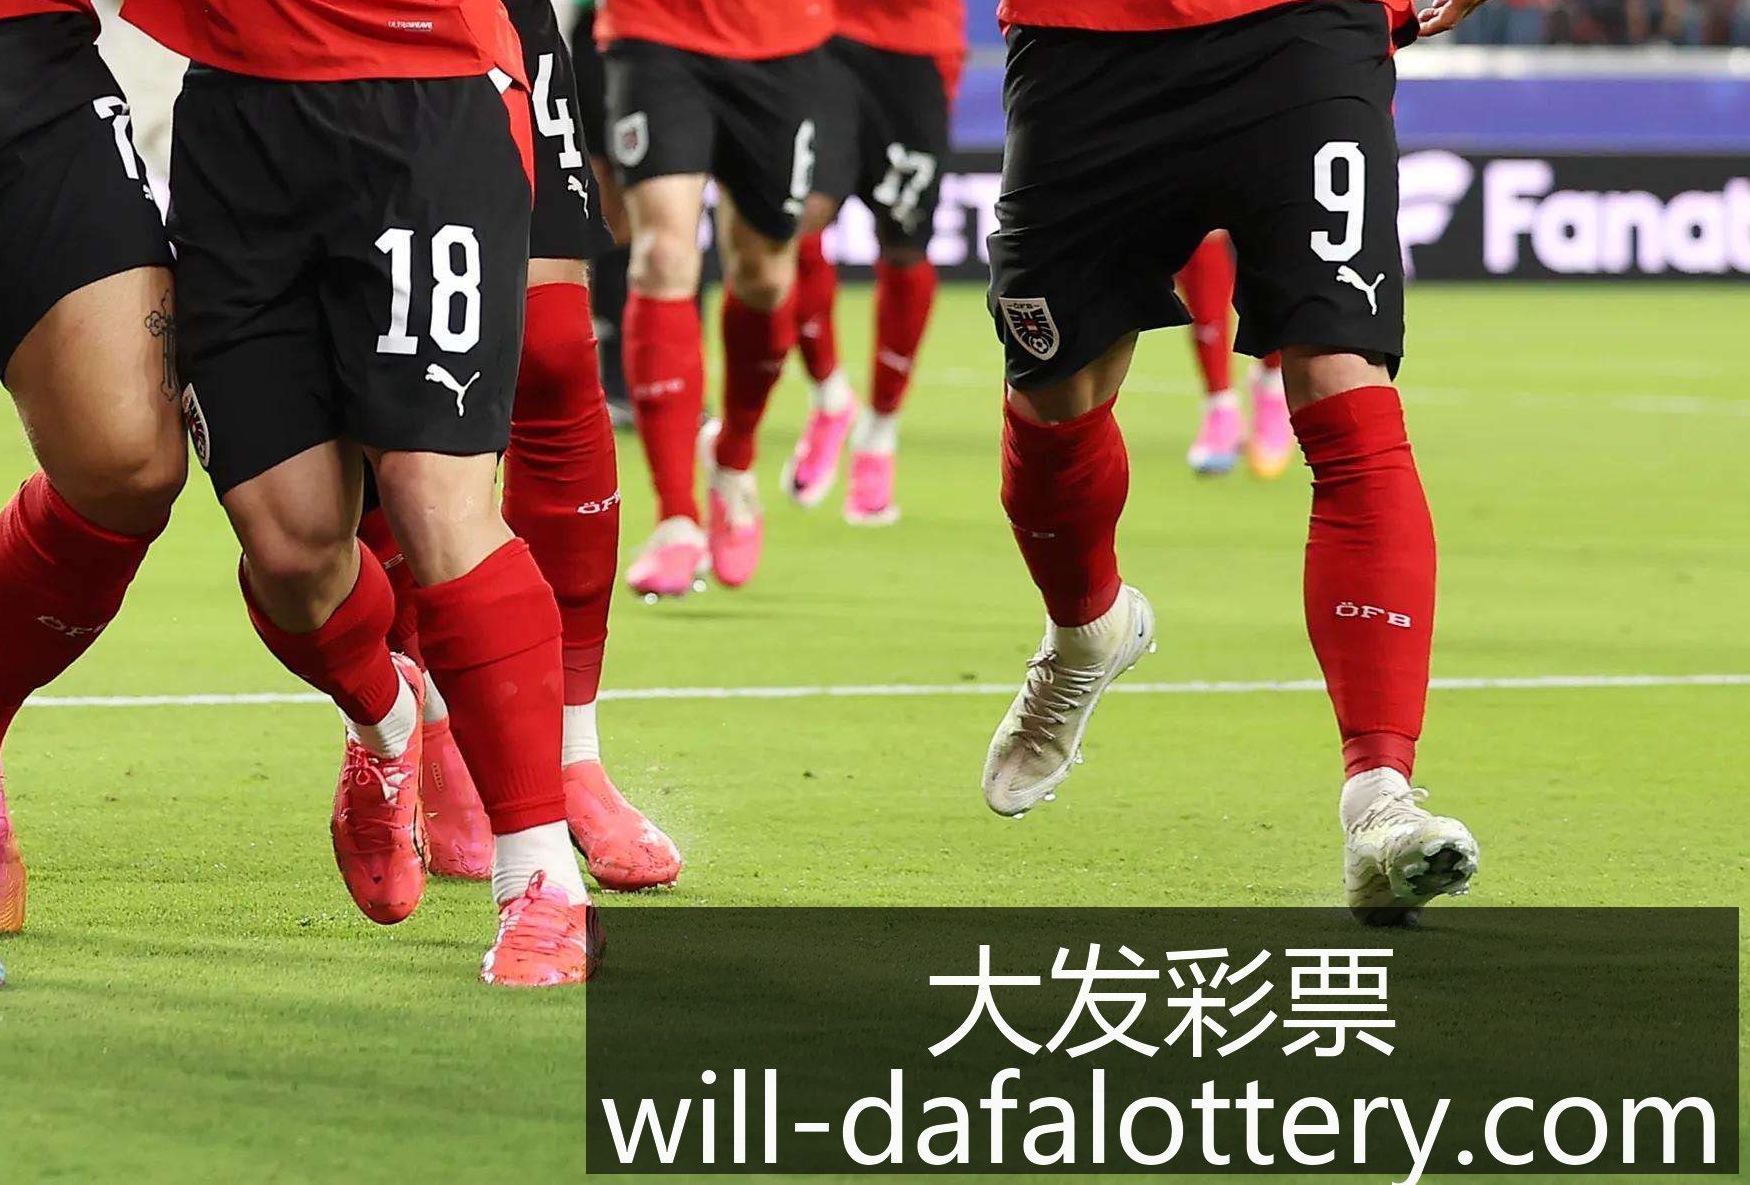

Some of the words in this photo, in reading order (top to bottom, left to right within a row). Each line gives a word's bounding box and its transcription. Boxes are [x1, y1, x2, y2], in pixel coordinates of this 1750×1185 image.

[92, 95, 139, 179] 7
[532, 53, 582, 168] 4
[1310, 141, 1365, 262] 9
[374, 224, 482, 355] 18
[1335, 601, 1410, 628] ÖFB
